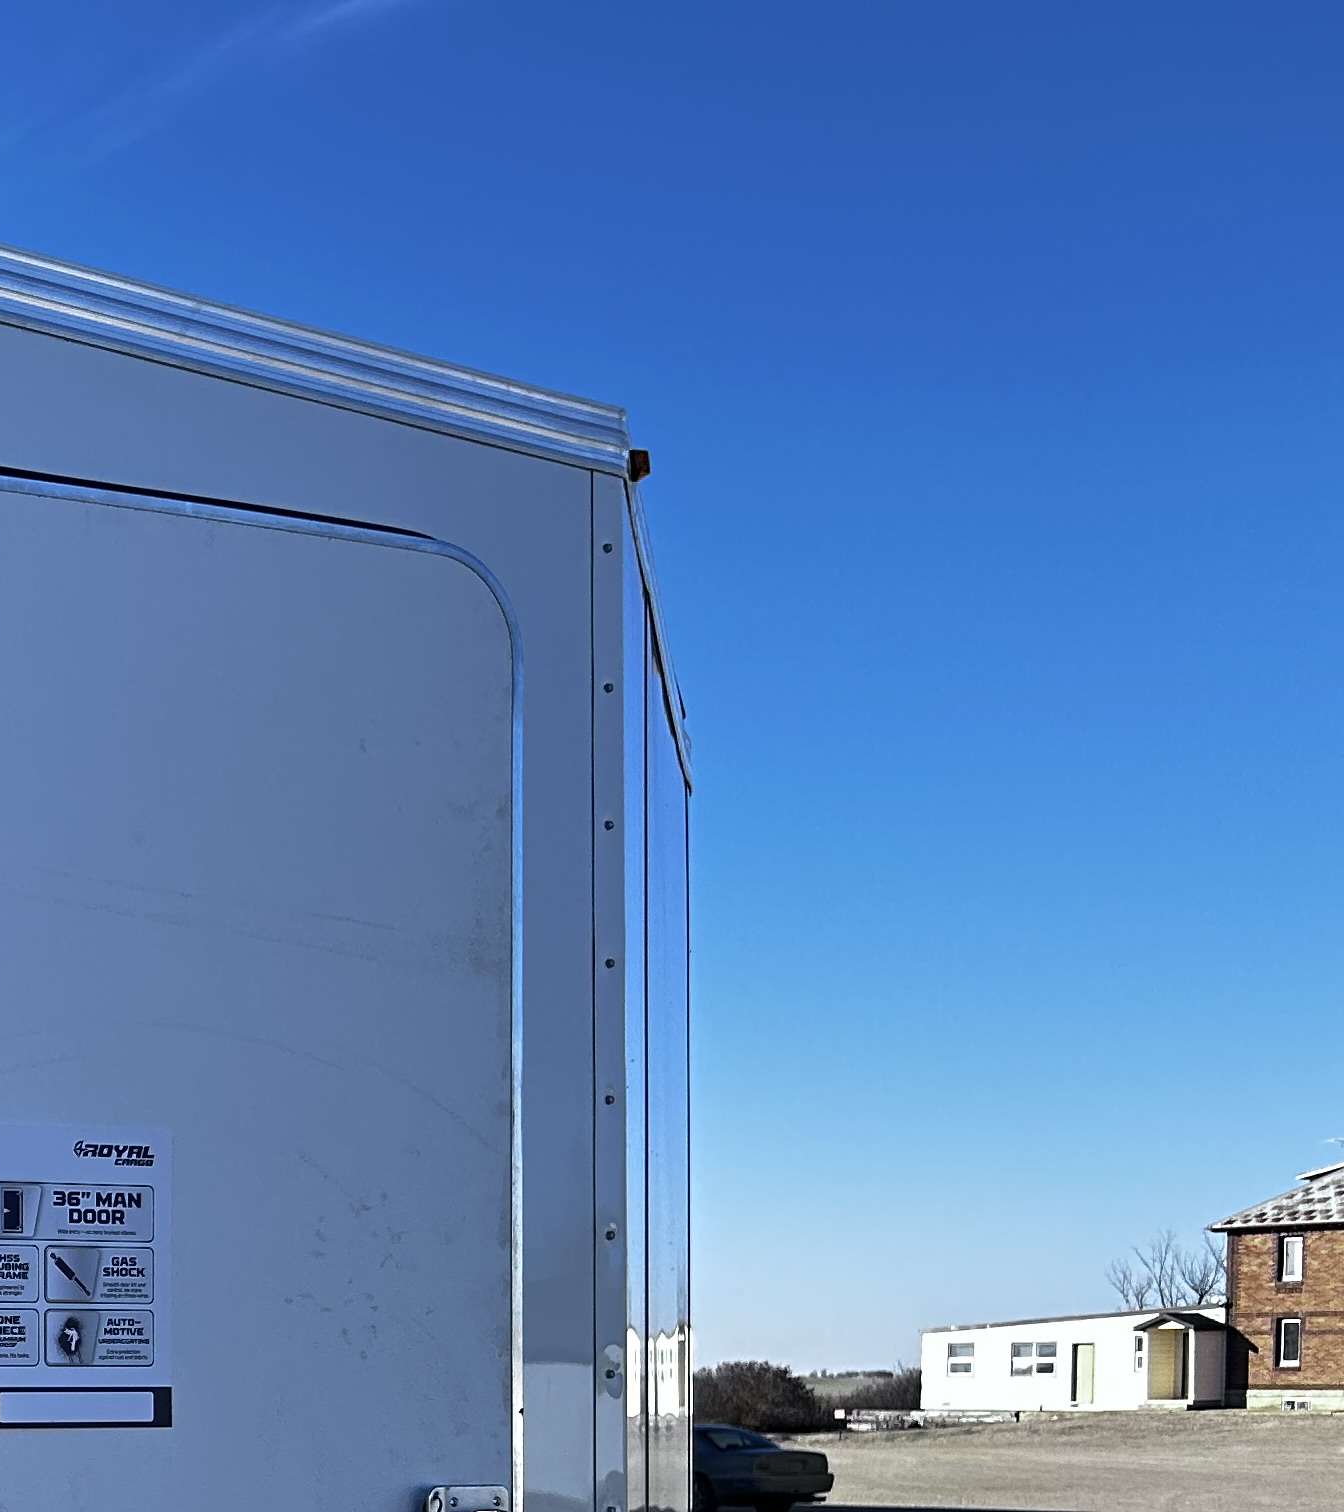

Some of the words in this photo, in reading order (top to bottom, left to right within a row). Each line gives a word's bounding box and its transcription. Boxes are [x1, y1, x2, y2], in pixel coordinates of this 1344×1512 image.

[81, 1143, 155, 1158] ROYAL
[114, 1158, 154, 1167] CARGO
[52, 1190, 91, 1207] 36"
[95, 1191, 142, 1208] MAN
[68, 1208, 125, 1225] DOOR
[111, 1256, 137, 1267] GAS
[102, 1267, 146, 1278] SHOCK
[106, 1318, 142, 1327] AUTO-
[103, 1328, 145, 1336] MOTIVE
